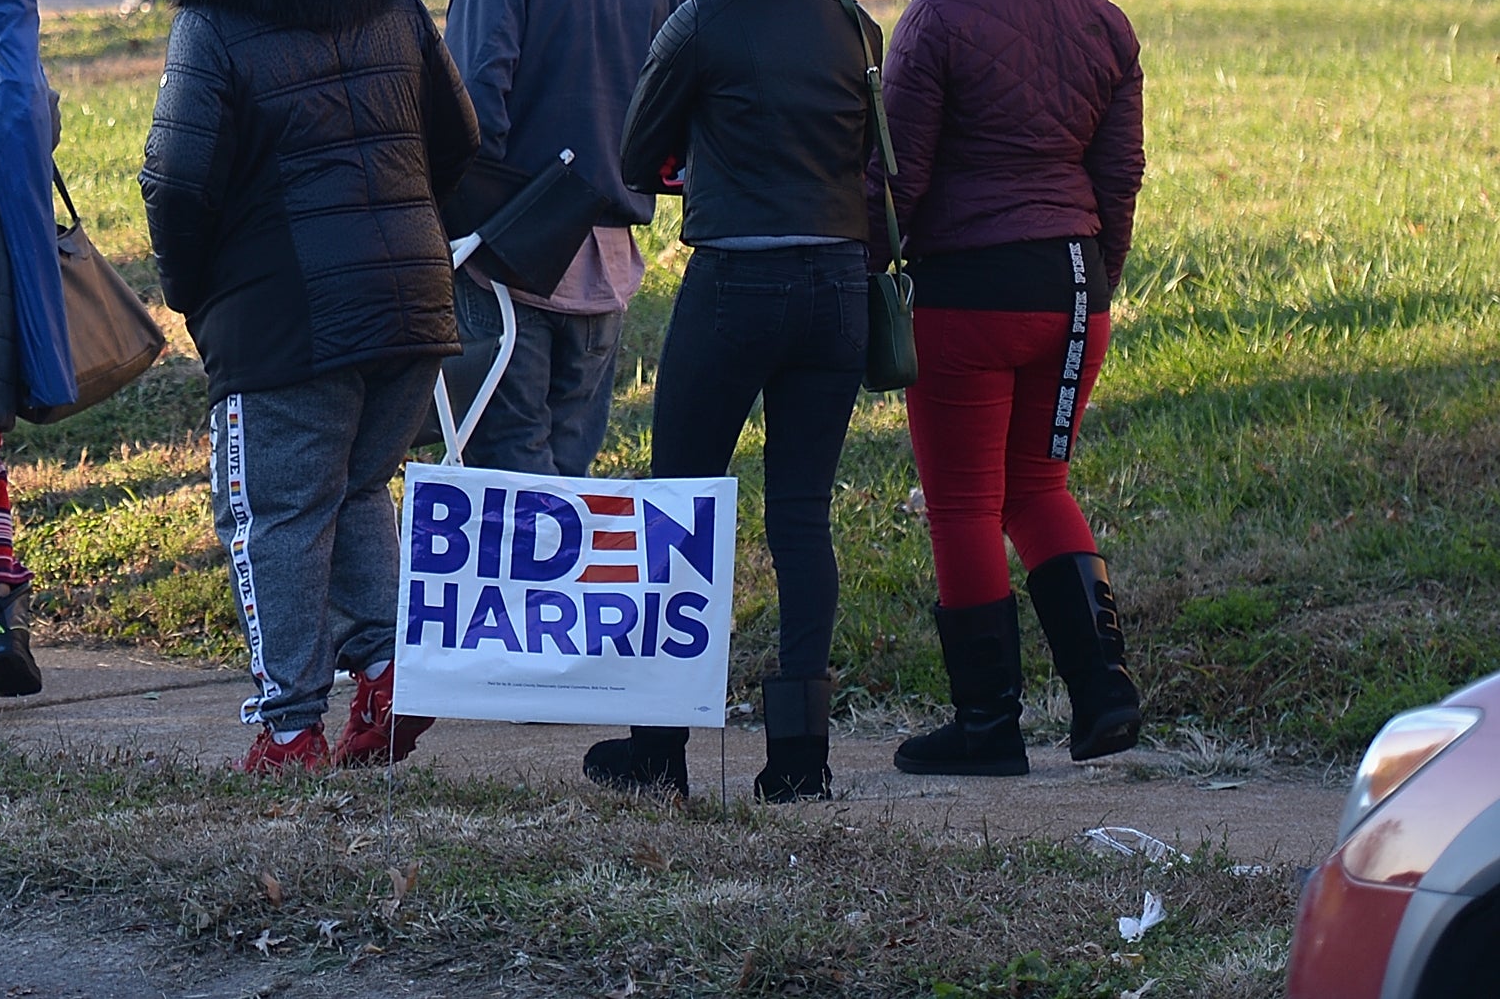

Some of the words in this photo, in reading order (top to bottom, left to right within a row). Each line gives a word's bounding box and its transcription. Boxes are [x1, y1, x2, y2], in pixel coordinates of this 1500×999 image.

[1069, 242, 1086, 284] PINK
[1073, 291, 1087, 333] PINK
[1064, 340, 1084, 381] PINK
[1056, 386, 1076, 427] PINK
[229, 435, 241, 475] LOVE
[410, 482, 716, 586] BIDEN
[236, 560, 253, 600] LOVE
[406, 580, 710, 659] HARRIS
